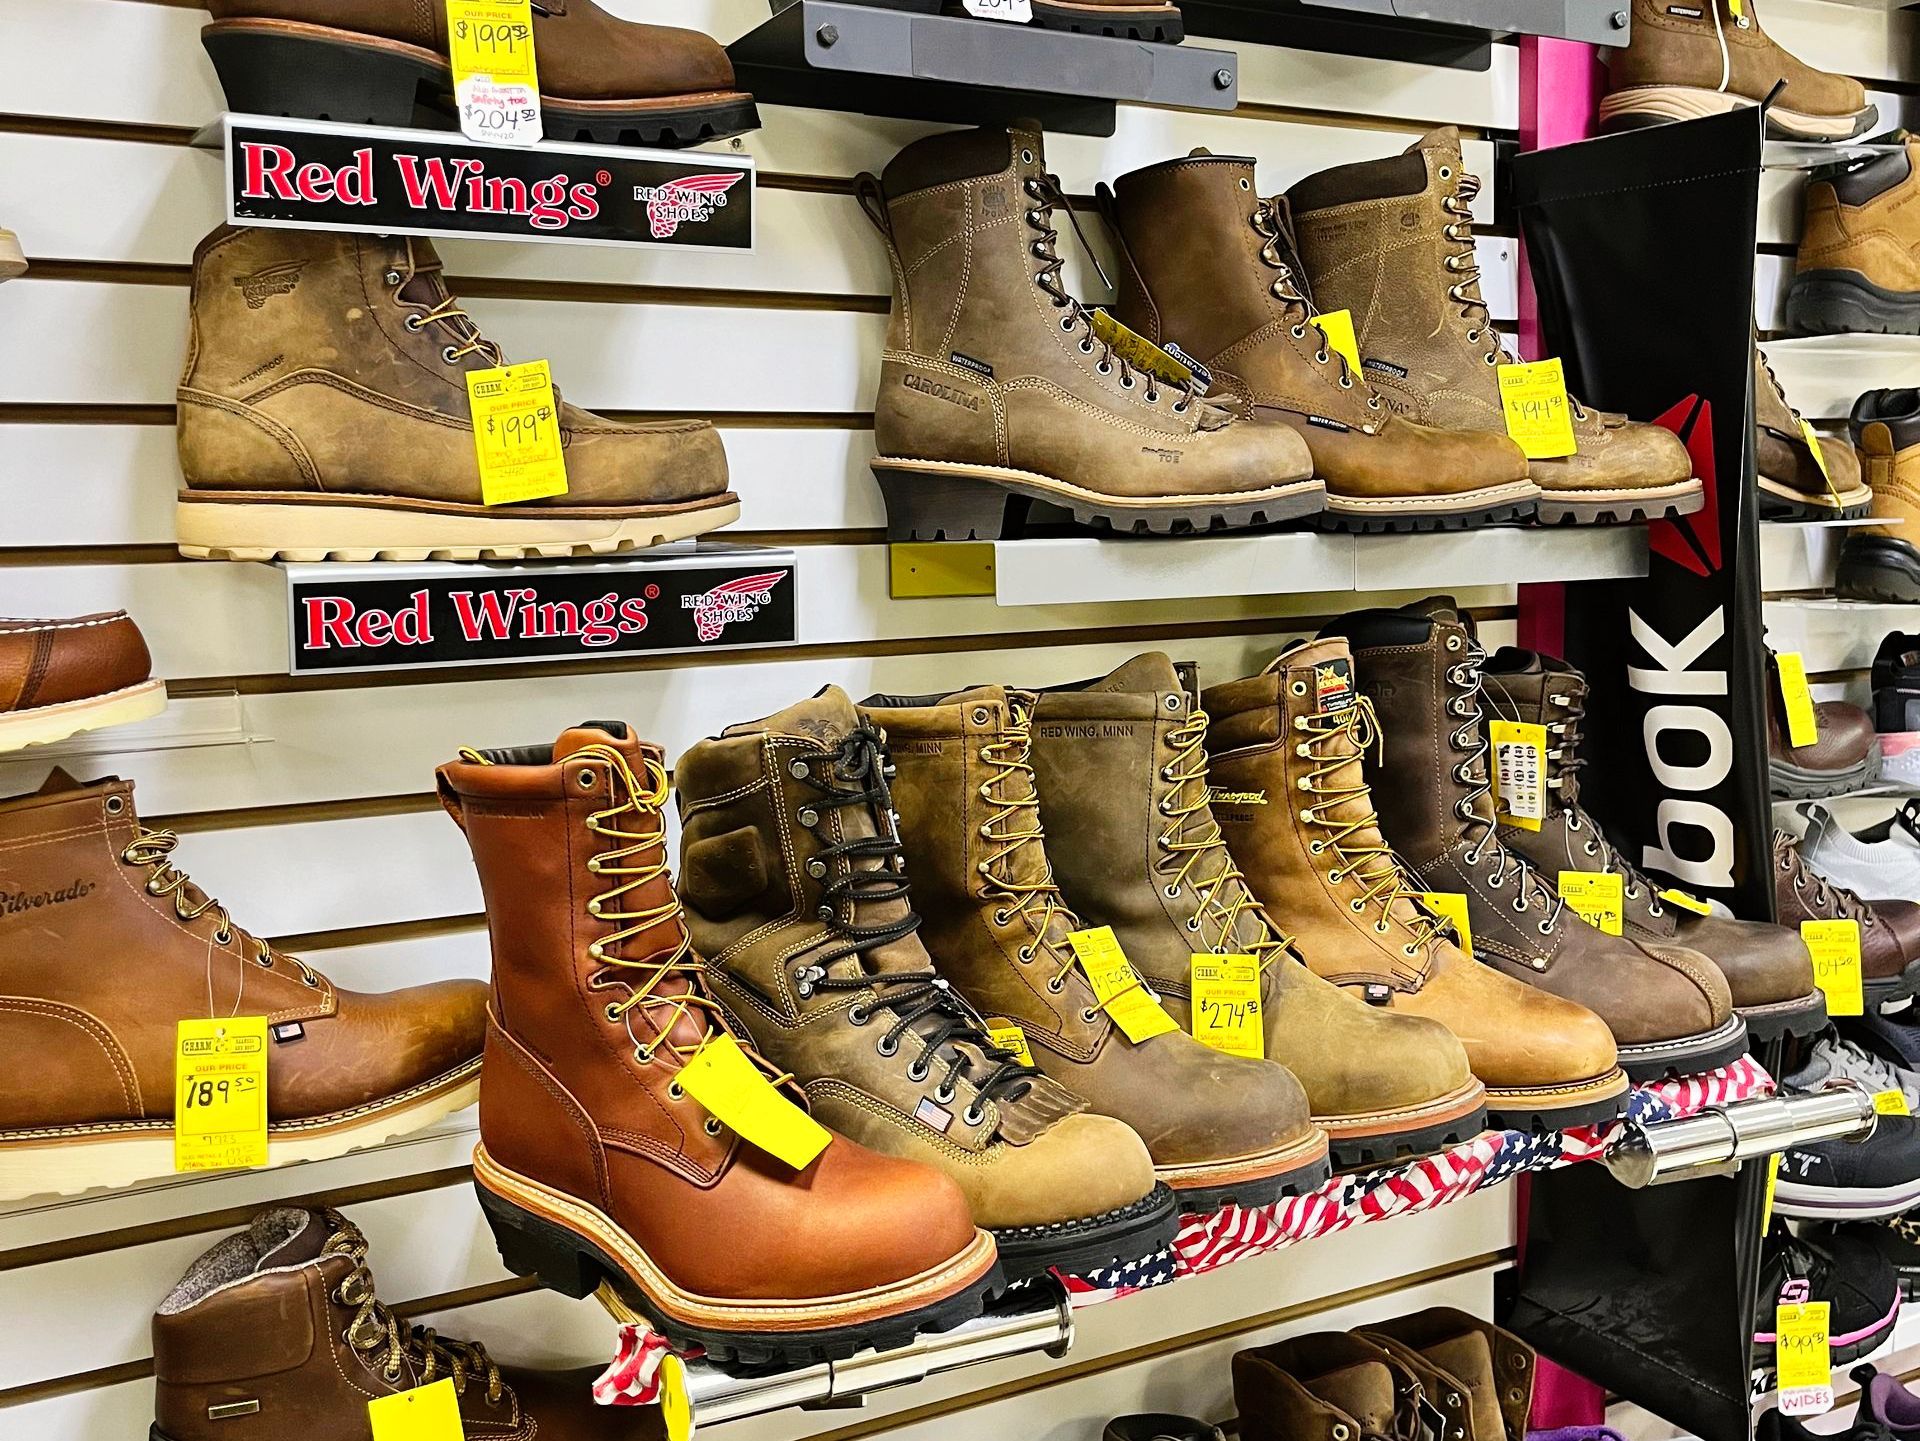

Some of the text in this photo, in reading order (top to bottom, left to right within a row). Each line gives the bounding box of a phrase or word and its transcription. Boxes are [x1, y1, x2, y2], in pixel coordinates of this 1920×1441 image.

[464, 9, 512, 19] OUR PRICE
[240, 142, 377, 206] Red
[633, 185, 728, 207] RED WING
[655, 206, 709, 222] SHOES
[952, 354, 991, 373] WATERPROOF
[490, 400, 538, 412] OUR PRICE
[681, 590, 772, 608] RED WING
[302, 589, 434, 649] Red
[702, 608, 754, 623] SHOES
[1040, 726, 1062, 738] RED
[1102, 725, 1134, 737] MINN
[185, 1041, 212, 1052] CHARM
[1782, 1391, 1830, 1411] WIDES
